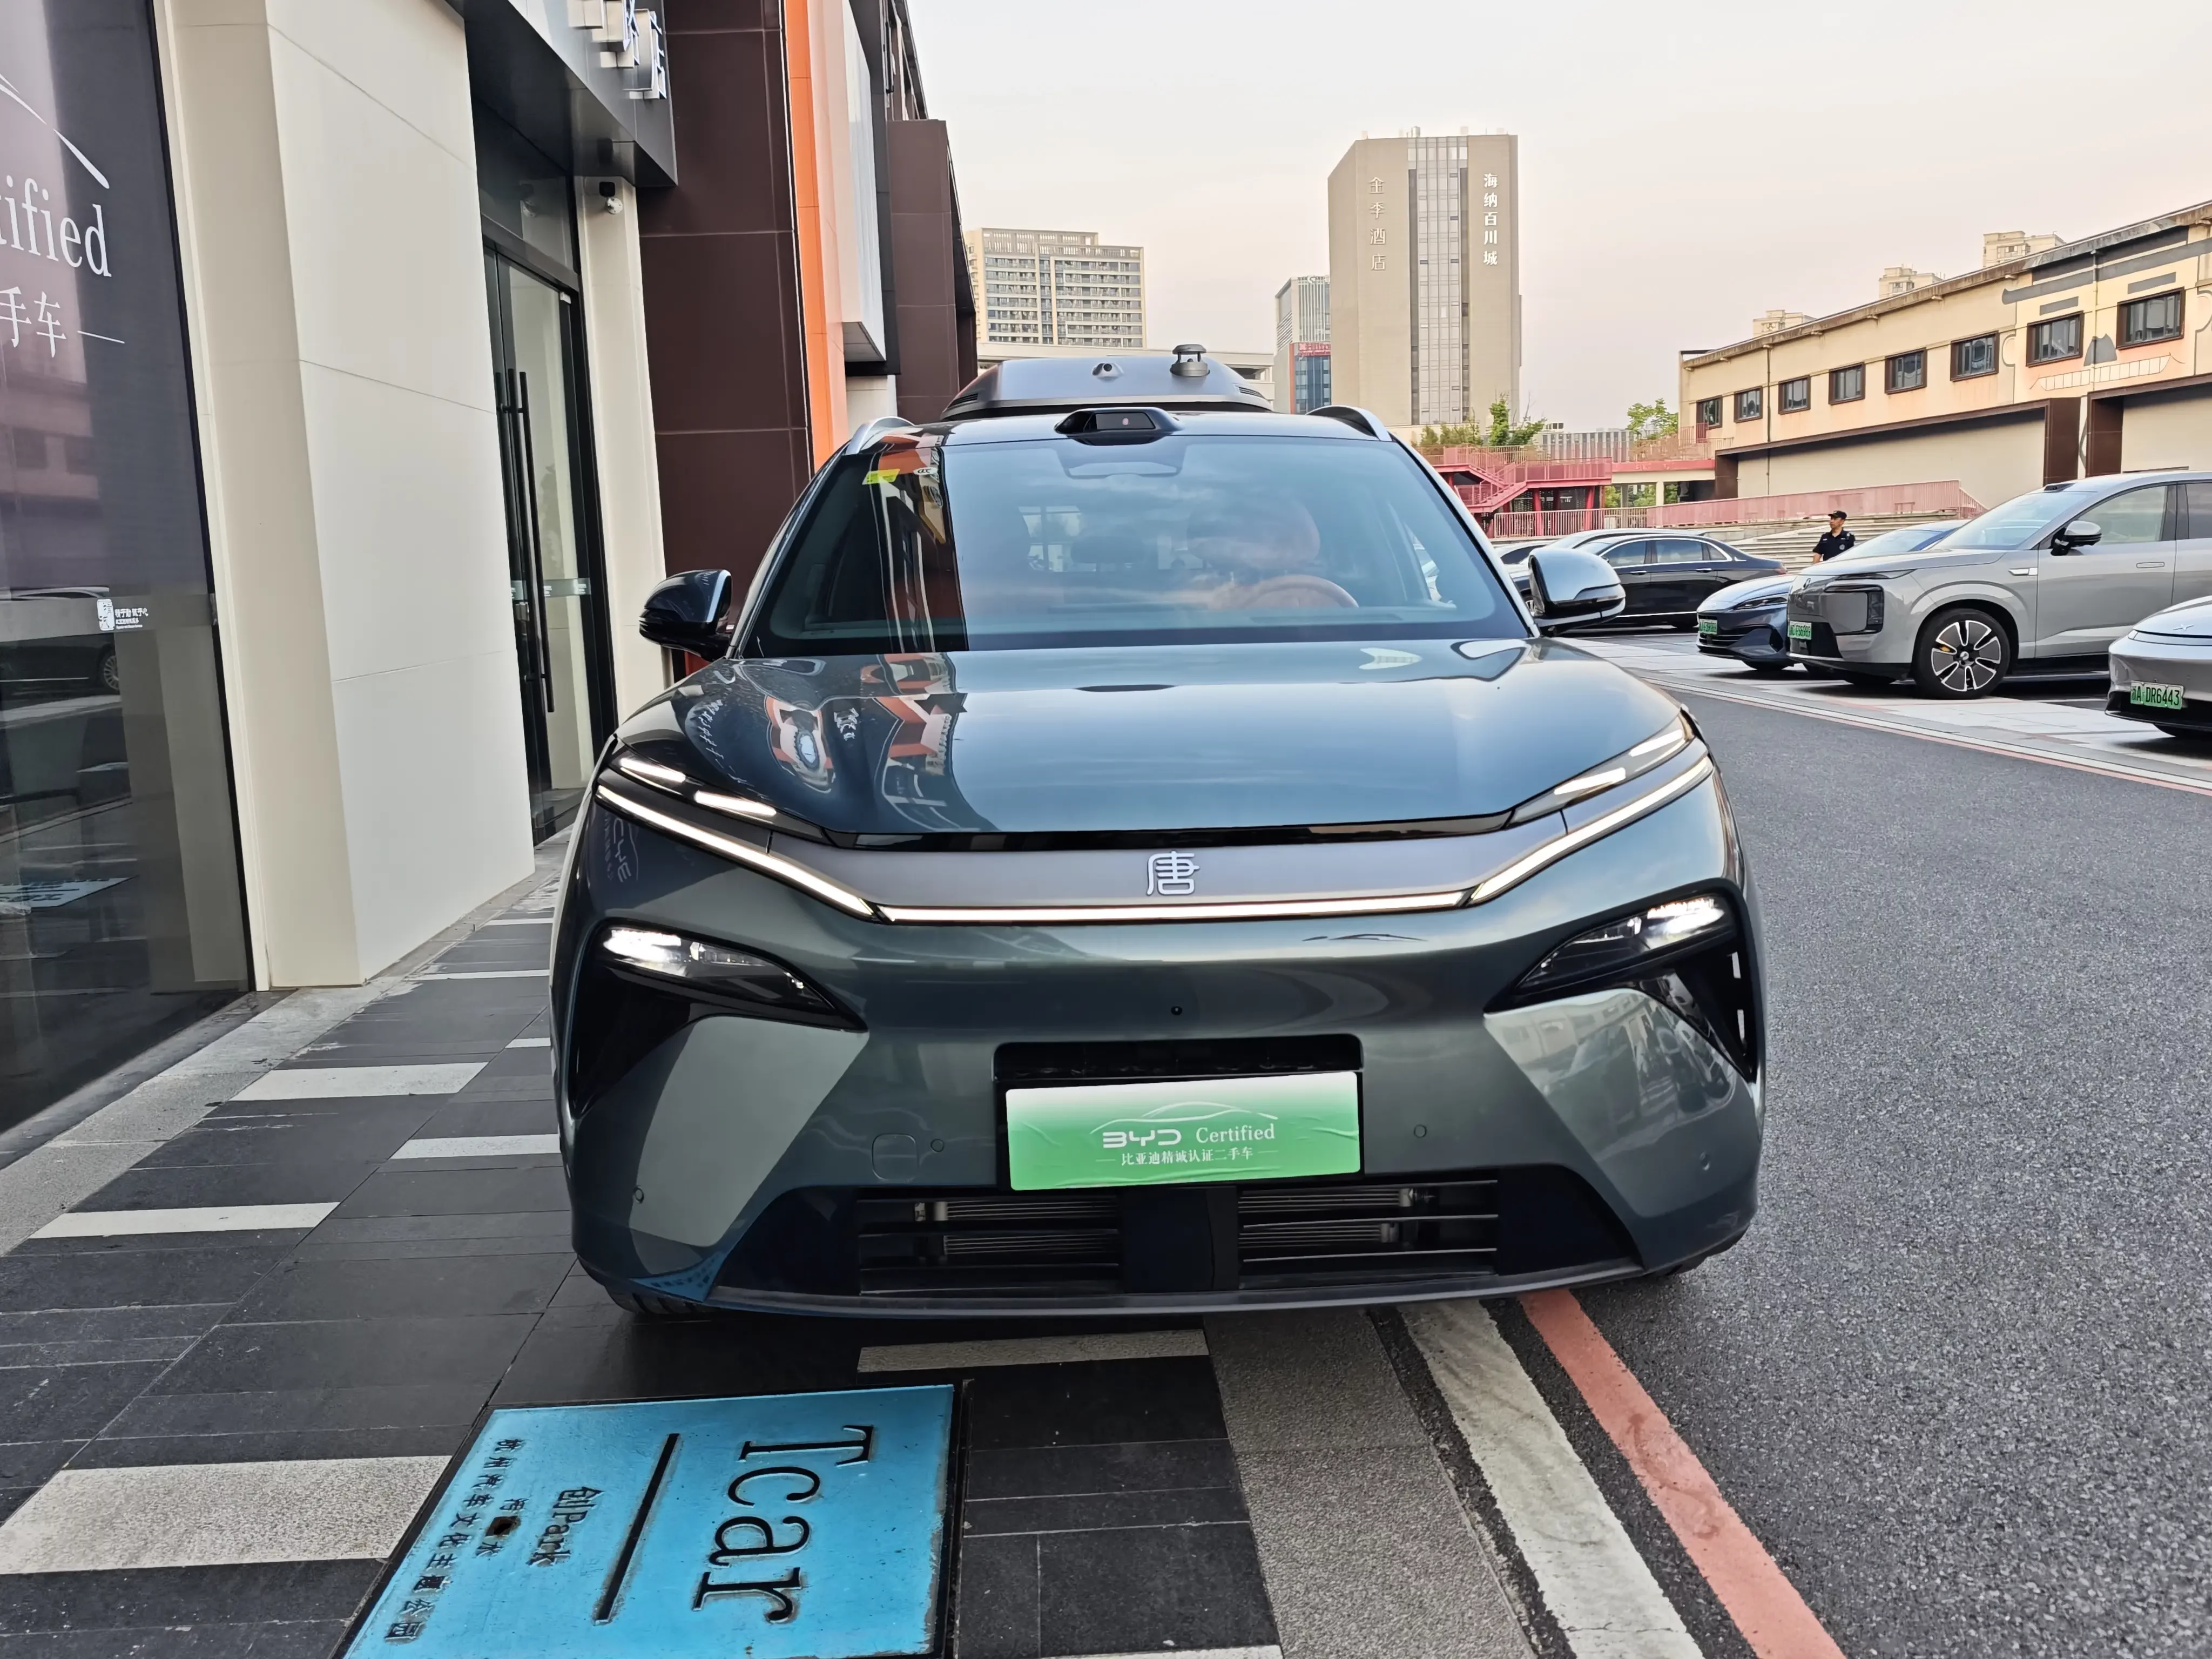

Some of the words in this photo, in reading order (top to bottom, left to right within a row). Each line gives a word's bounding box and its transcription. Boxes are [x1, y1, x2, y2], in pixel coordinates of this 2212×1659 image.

[0, 175, 112, 277] ified
[1483, 173, 1498, 266] 海纳百川城
[2145, 686, 2180, 706] DR6443
[1147, 850, 1200, 896] 唐
[1103, 1129, 1182, 1148] BYD
[1196, 1123, 1275, 1144] Certified
[1121, 1146, 1254, 1166] 比亚迪精诚认证二手车
[384, 1438, 527, 1641] 杭州汽车文化主题公园
[691, 1424, 874, 1624] Tcar
